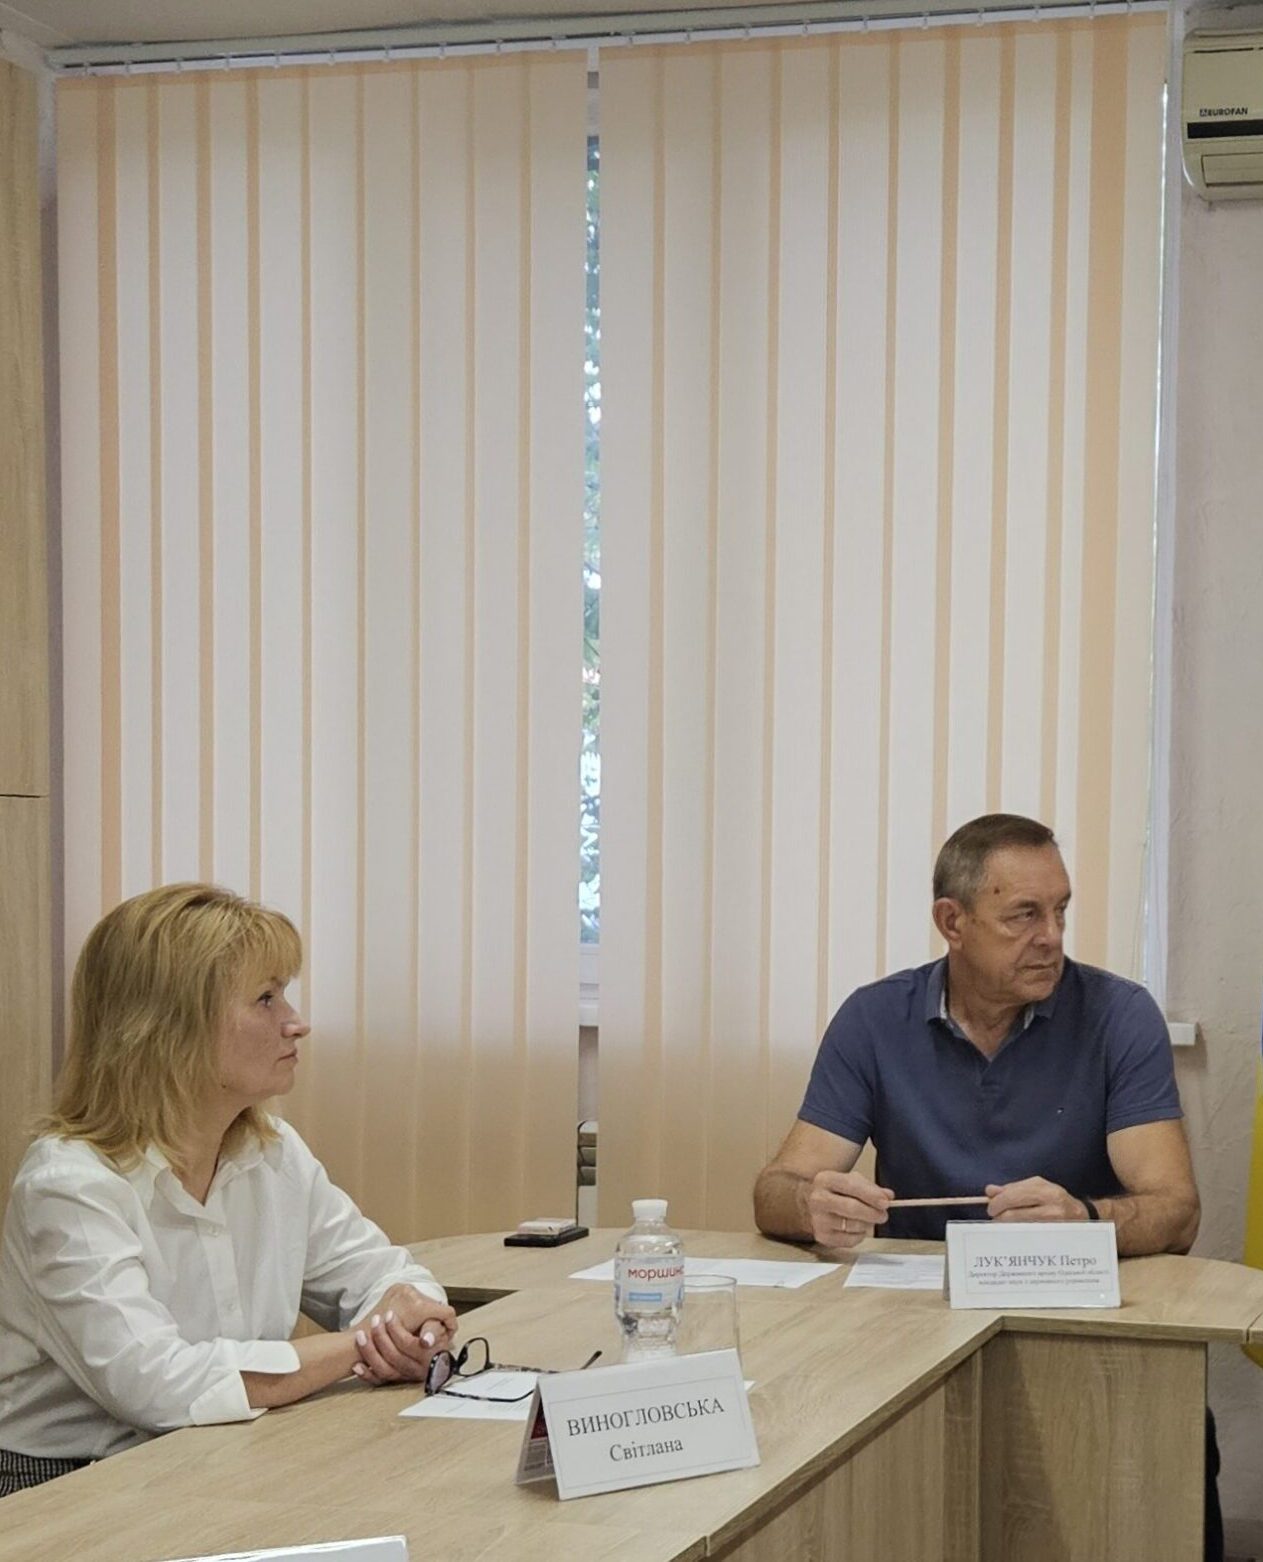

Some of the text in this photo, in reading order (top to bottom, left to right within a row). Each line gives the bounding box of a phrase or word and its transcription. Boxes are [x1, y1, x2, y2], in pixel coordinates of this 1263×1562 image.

[1060, 1255, 1097, 1269] Петро
[566, 1397, 725, 1437] ВИНОГЛОВСЬКА
[609, 1438, 684, 1462] Світлана
